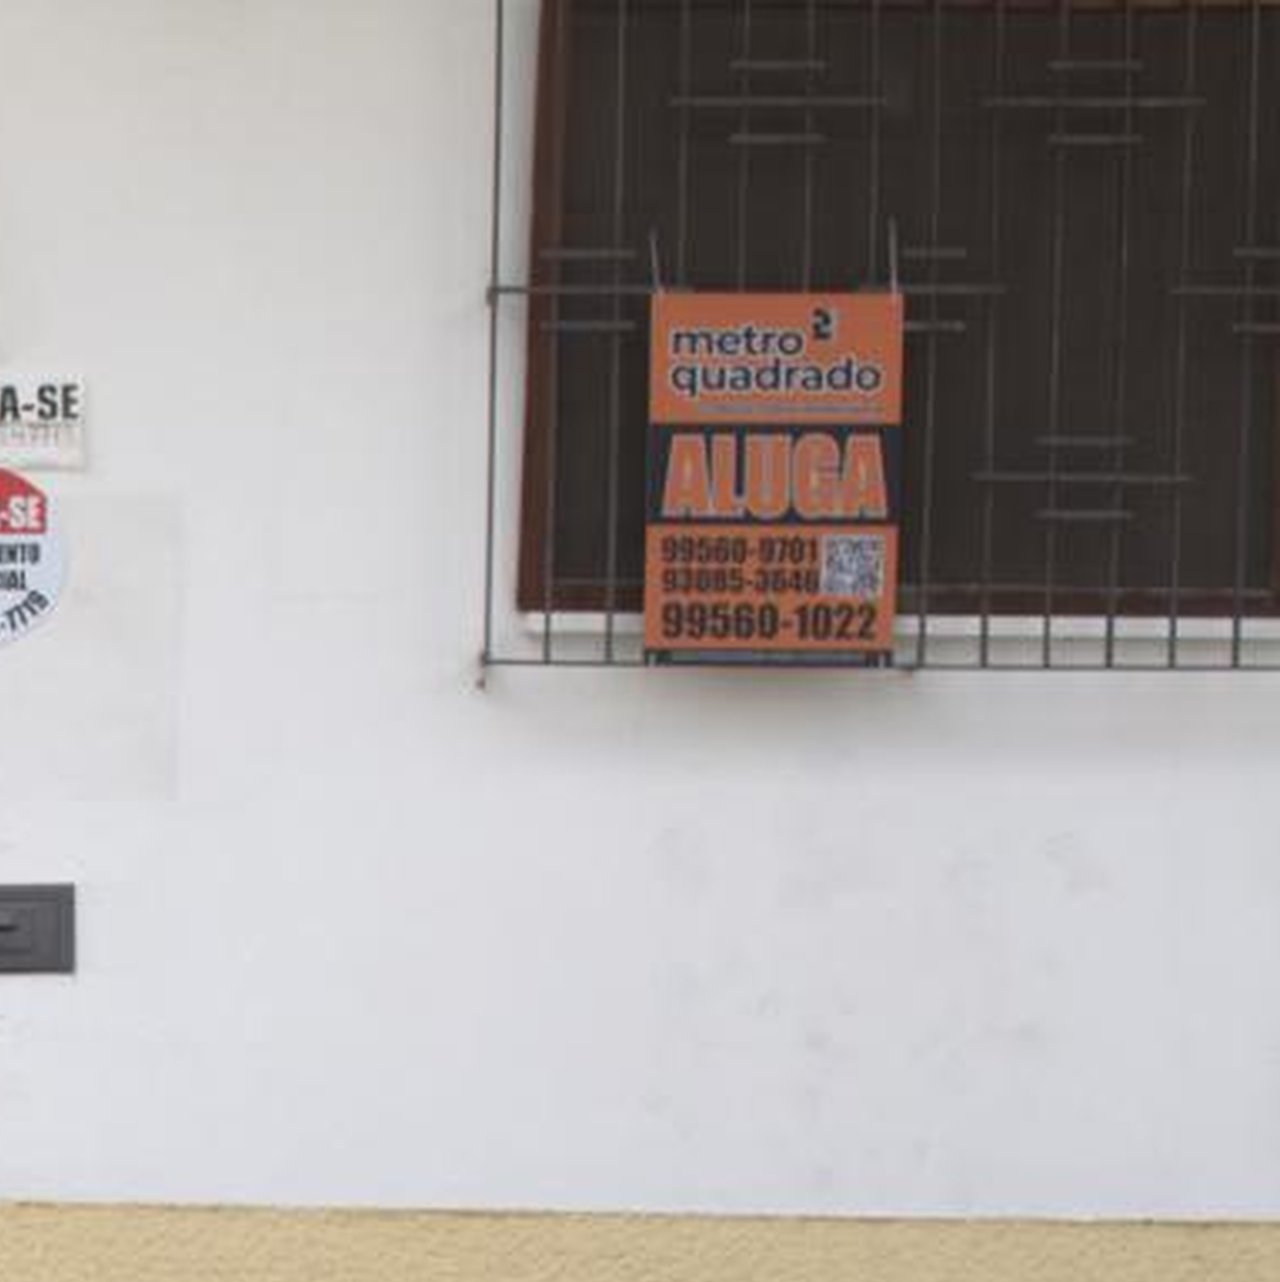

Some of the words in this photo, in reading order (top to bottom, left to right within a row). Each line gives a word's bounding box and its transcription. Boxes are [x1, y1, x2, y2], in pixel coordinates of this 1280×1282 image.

[671, 327, 803, 355] metro
[671, 359, 883, 396] quadrado
[661, 433, 888, 519] ALUGA
[661, 602, 877, 641] 99560-1022
